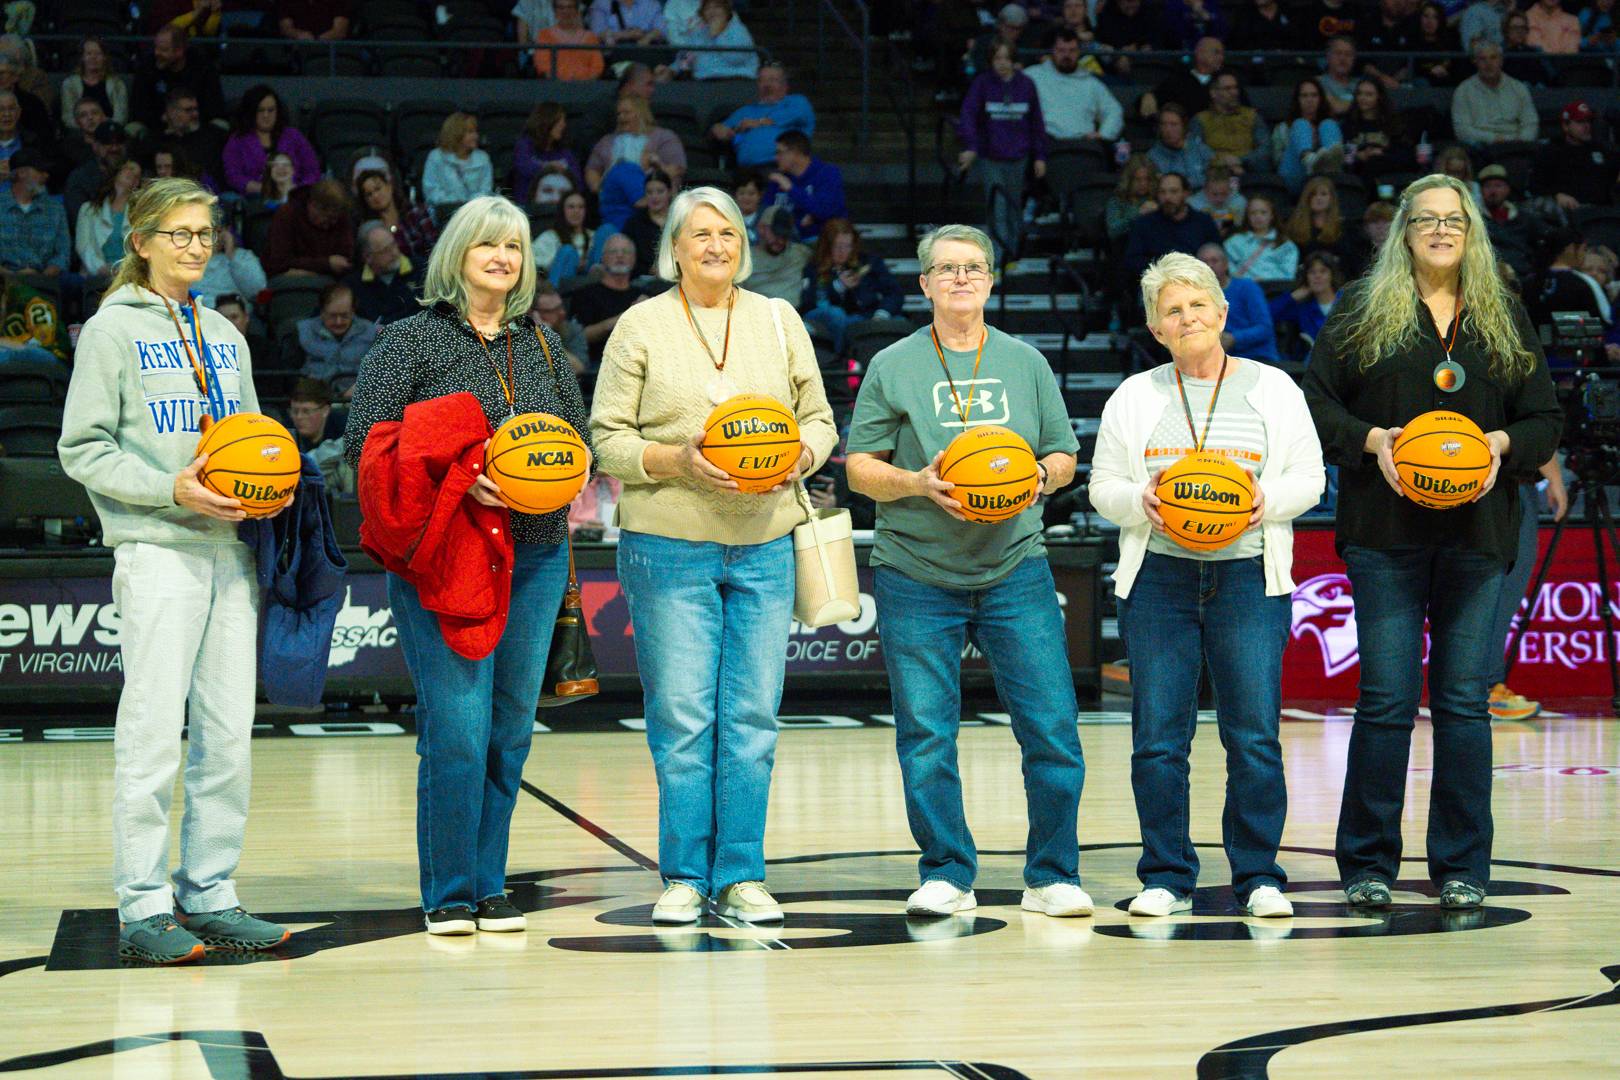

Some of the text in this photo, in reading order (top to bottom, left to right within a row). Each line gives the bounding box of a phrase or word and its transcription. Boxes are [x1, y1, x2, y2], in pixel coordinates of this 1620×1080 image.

[134, 339, 240, 370] KENTCKY
[508, 420, 577, 441] Wilson
[721, 416, 790, 439] Wilson
[526, 451, 574, 467] NCAA
[233, 479, 295, 501] Wilson
[1413, 471, 1478, 494] Wilson
[967, 489, 1031, 509] Wilson
[1174, 482, 1240, 506] Wilson
[331, 626, 398, 648] SSAC
[846, 640, 879, 661] OF
[19, 652, 122, 673] VIRGINIA
